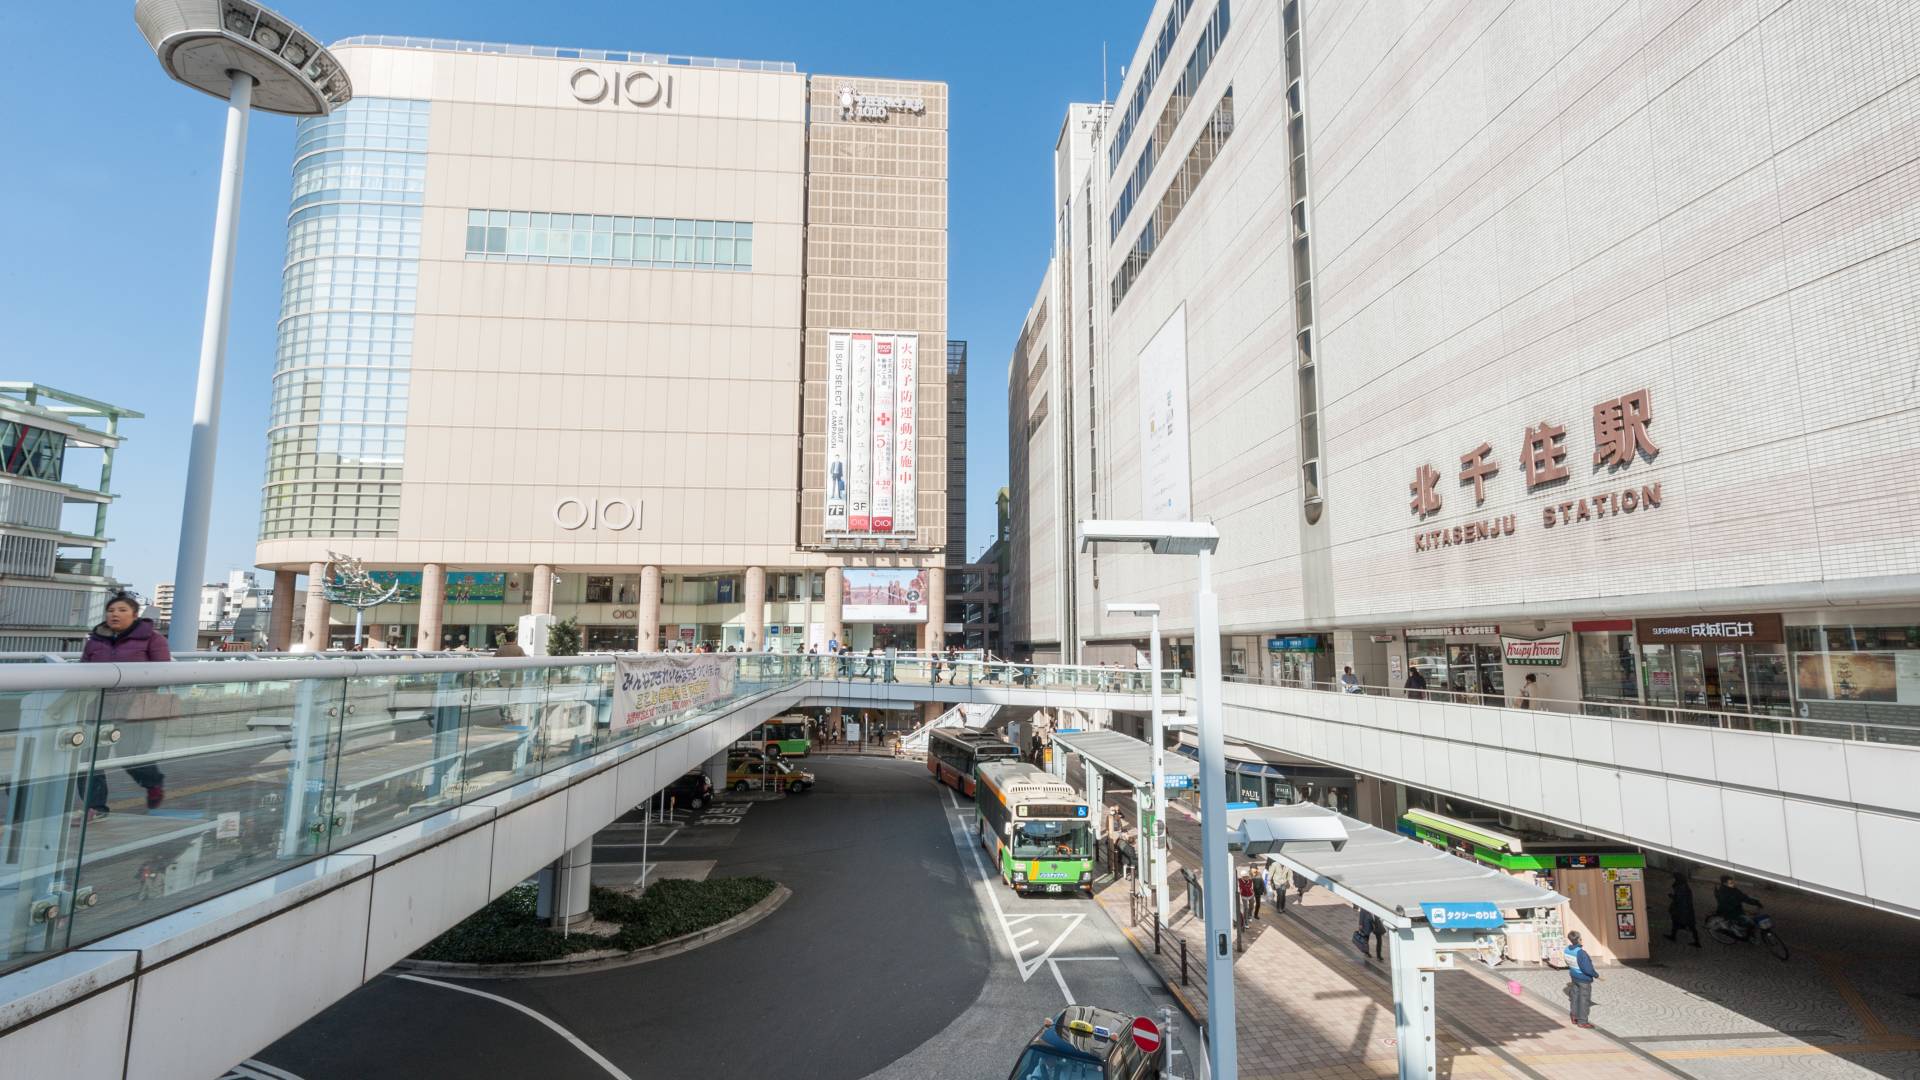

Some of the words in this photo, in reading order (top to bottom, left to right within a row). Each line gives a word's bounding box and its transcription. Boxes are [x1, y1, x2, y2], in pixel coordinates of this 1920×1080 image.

[835, 353, 843, 372] SUIT
[900, 343, 913, 485] 火災予防運動実施中
[1410, 388, 1659, 515] 北千住駅
[829, 505, 844, 516] 7F
[853, 502, 867, 511] 3F
[1415, 514, 1516, 552] KITASENJU
[1543, 482, 1662, 528] STATION
[1652, 626, 1690, 635] SUPERMARKET
[1691, 621, 1754, 637] 成城石井
[1507, 641, 1531, 659] Krispy
[1532, 641, 1560, 656] Kreme
[1241, 789, 1259, 799] PAUL
[1447, 911, 1497, 920] タクシーのりば
